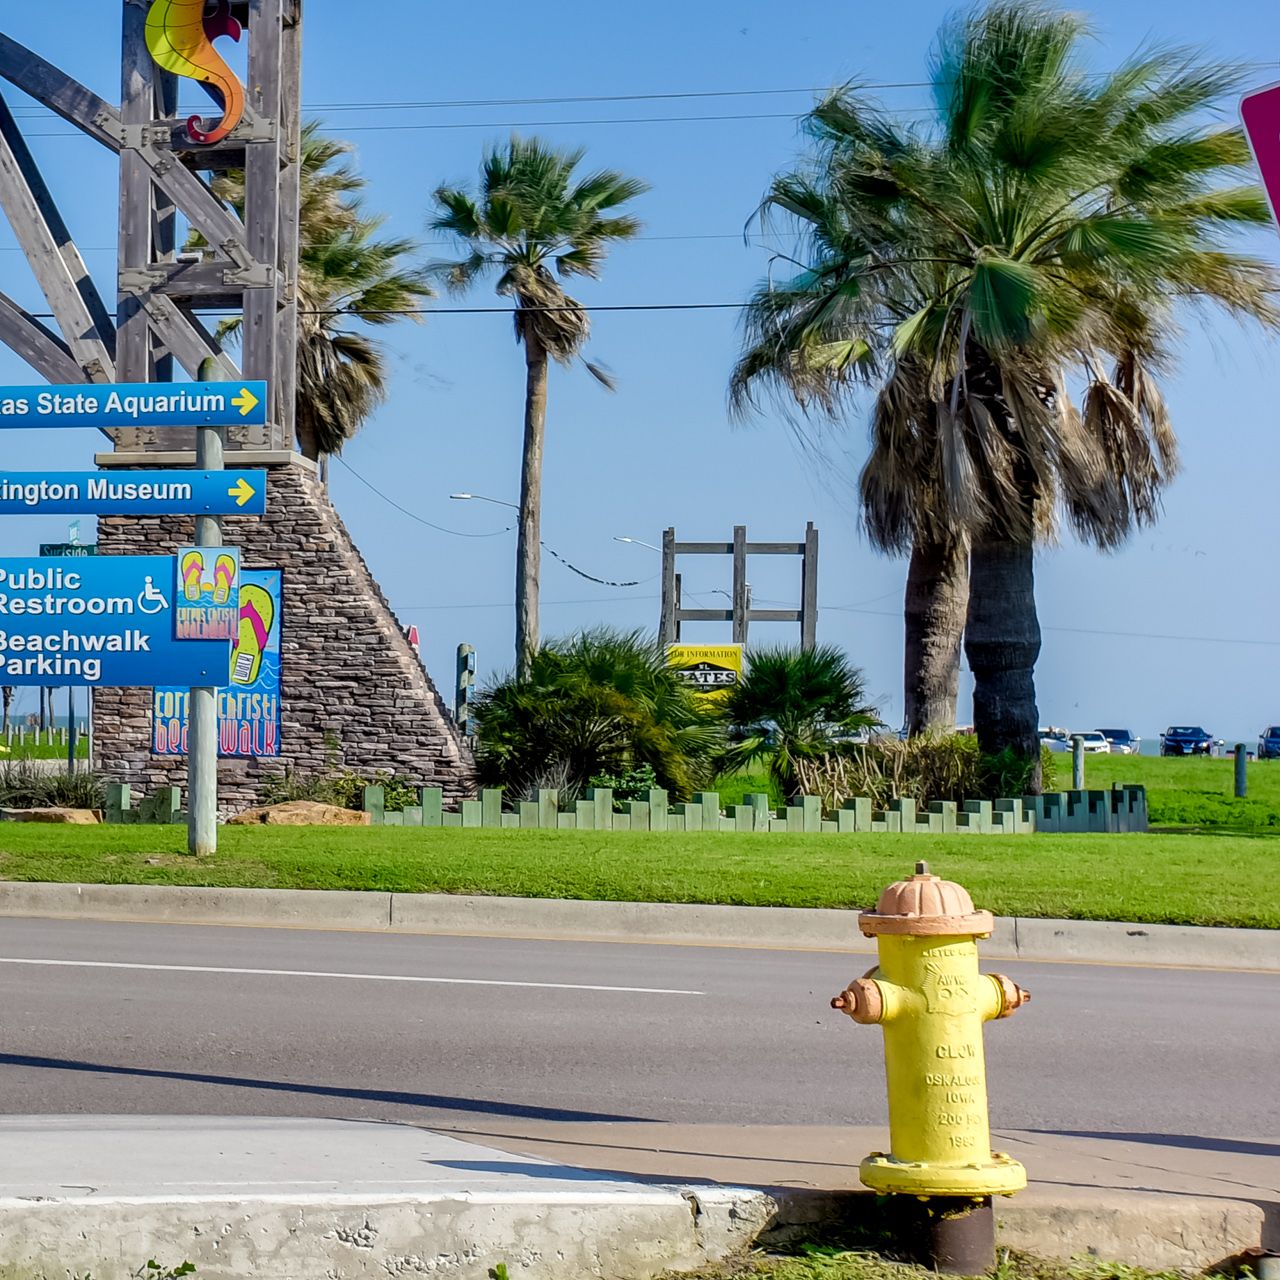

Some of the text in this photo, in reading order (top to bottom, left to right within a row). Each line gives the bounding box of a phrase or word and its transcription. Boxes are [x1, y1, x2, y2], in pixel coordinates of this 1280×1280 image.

[36, 394, 98, 415] State
[105, 391, 225, 417] Aquarium
[88, 480, 191, 500] Museum
[687, 650, 738, 658] INFORMATION
[155, 691, 277, 720] corp christi
[155, 718, 276, 755] beawalk
[935, 1044, 975, 1059] CLOW
[946, 1091, 975, 1104] IOWA
